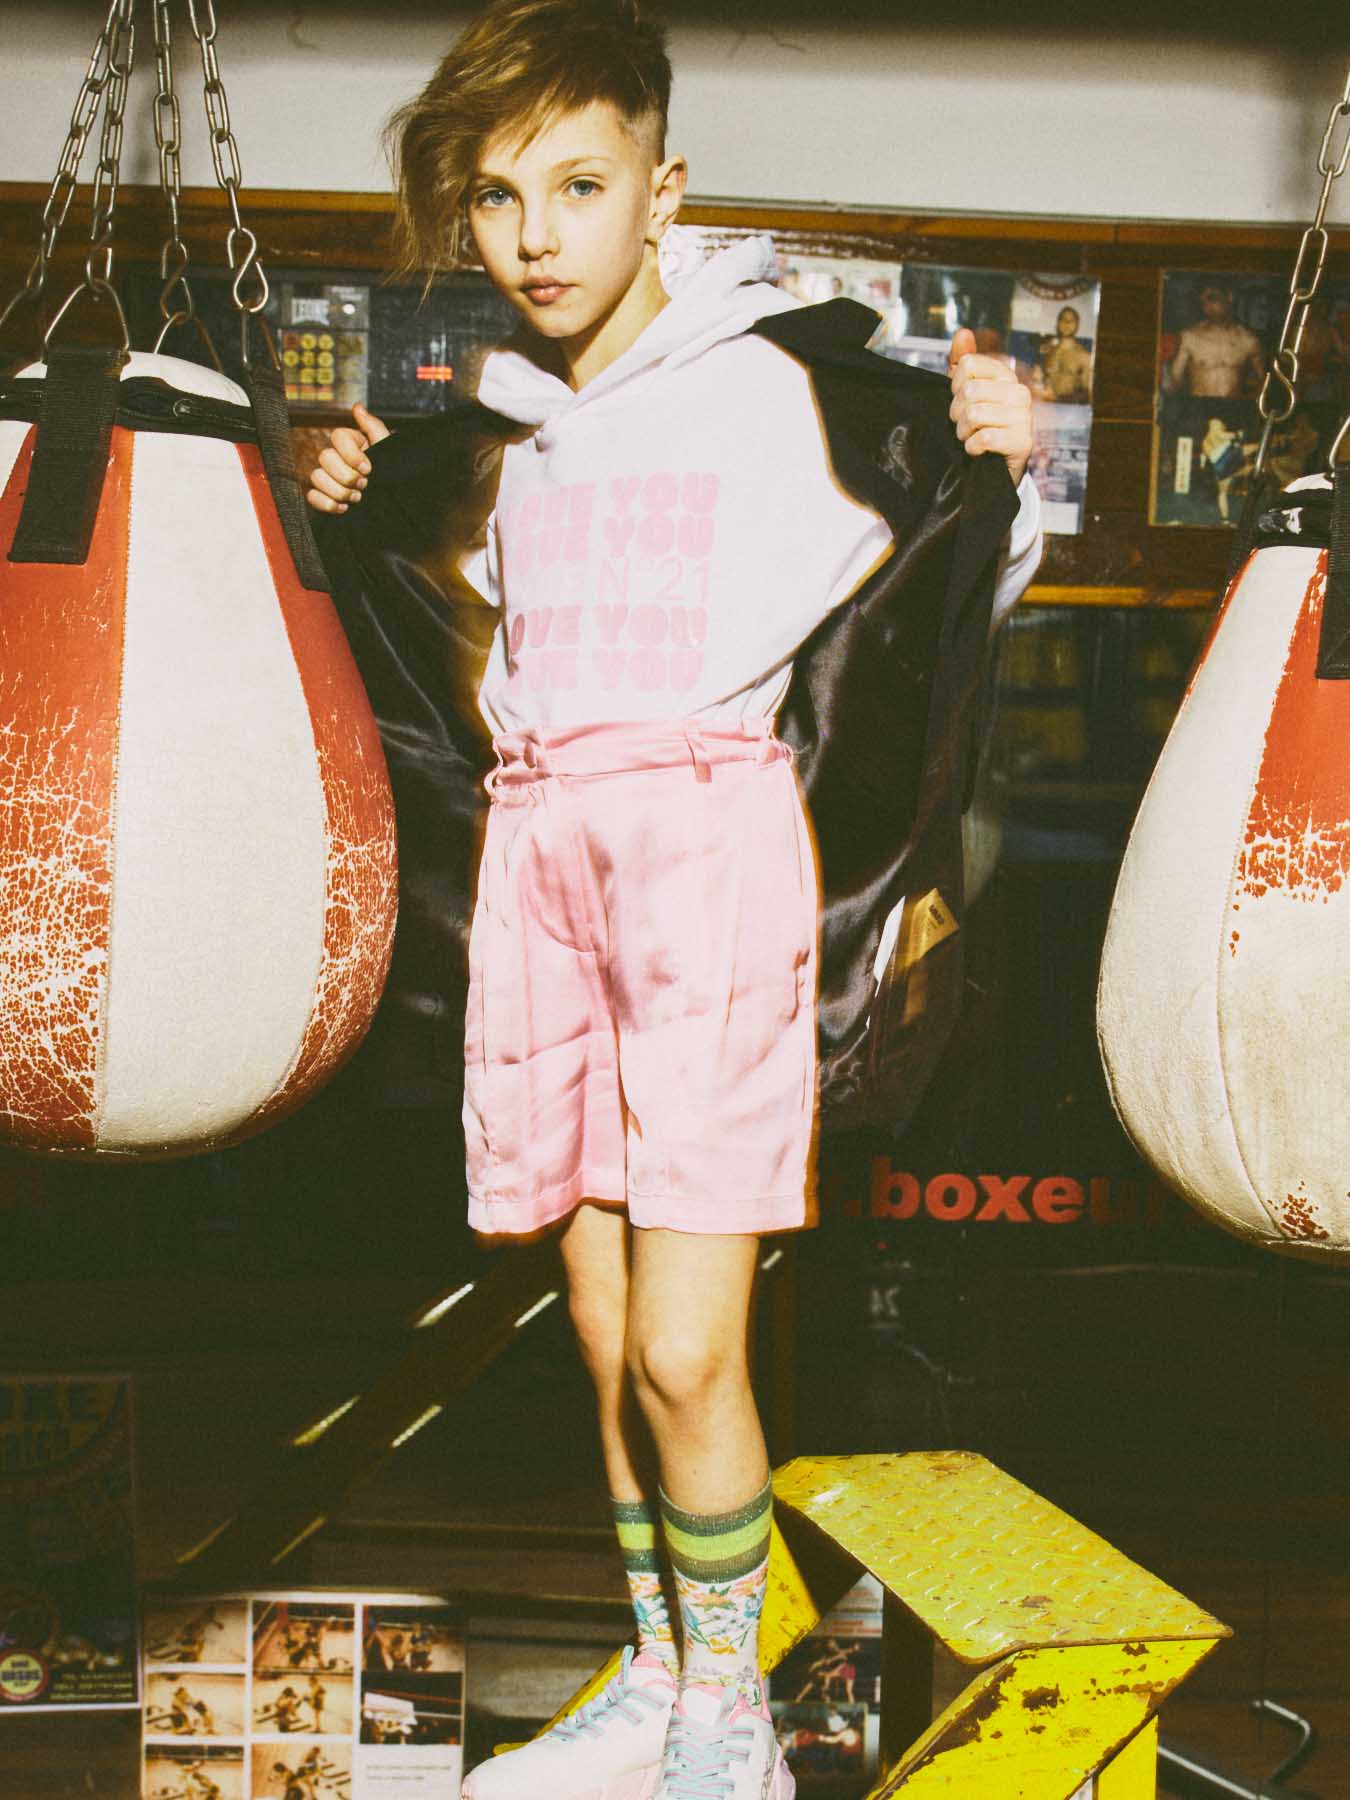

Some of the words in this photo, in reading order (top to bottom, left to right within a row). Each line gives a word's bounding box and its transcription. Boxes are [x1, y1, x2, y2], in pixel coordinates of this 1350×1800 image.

[611, 472, 719, 515] YOU
[604, 514, 713, 557] YOU
[592, 604, 707, 648] YOU
[592, 650, 704, 692] YOU
